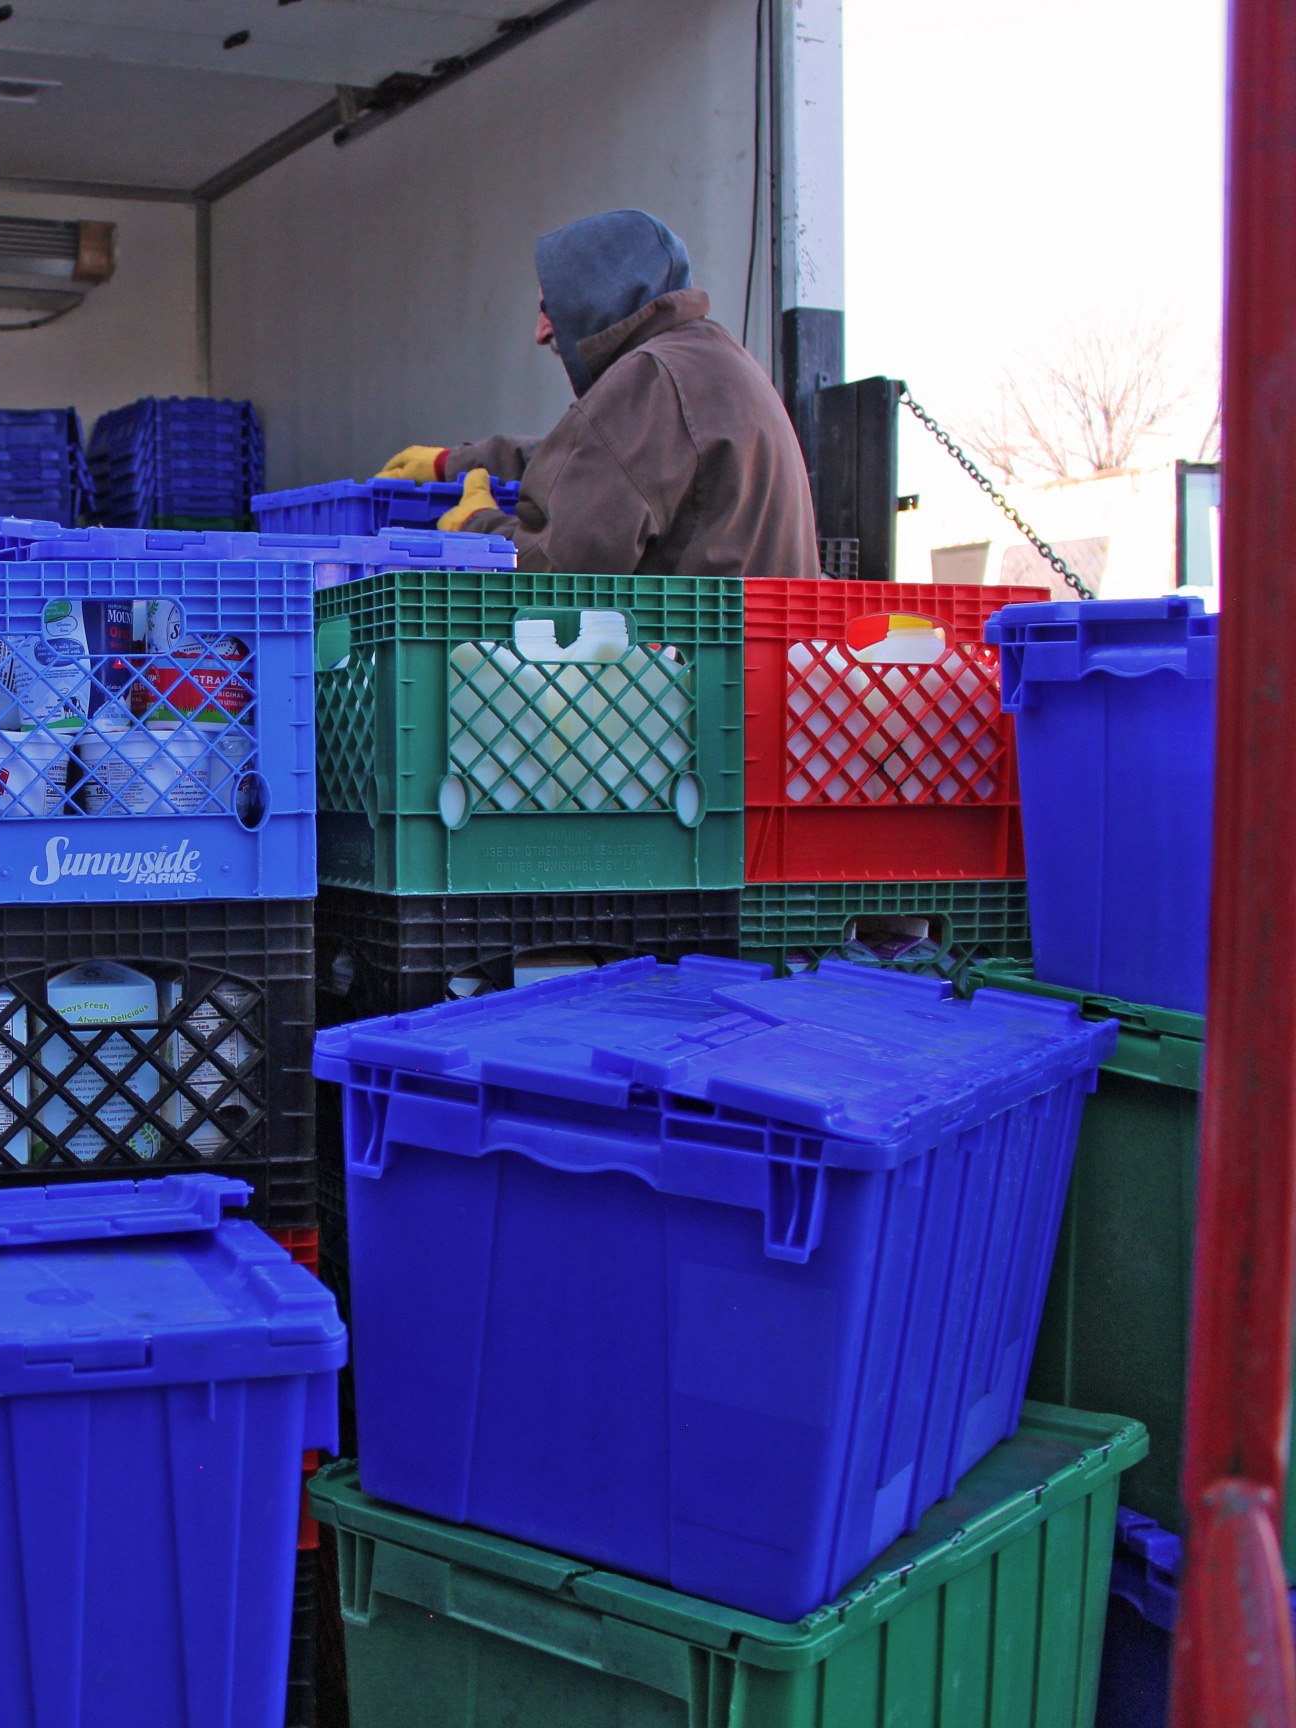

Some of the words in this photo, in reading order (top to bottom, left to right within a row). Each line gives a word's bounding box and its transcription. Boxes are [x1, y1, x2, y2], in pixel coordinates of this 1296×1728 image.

[482, 846, 502, 858] USE
[508, 846, 520, 858] BY
[525, 846, 559, 857] OTHER
[593, 844, 656, 856] REGISTERED
[29, 836, 202, 886] Sunnyside
[496, 861, 532, 873] OWNER
[538, 860, 600, 872] PUNISHABLE
[135, 872, 197, 884] FARMS
[57, 1004, 82, 1016] lways
[84, 1002, 109, 1010] Fresh
[111, 1004, 149, 1022] Delicious
